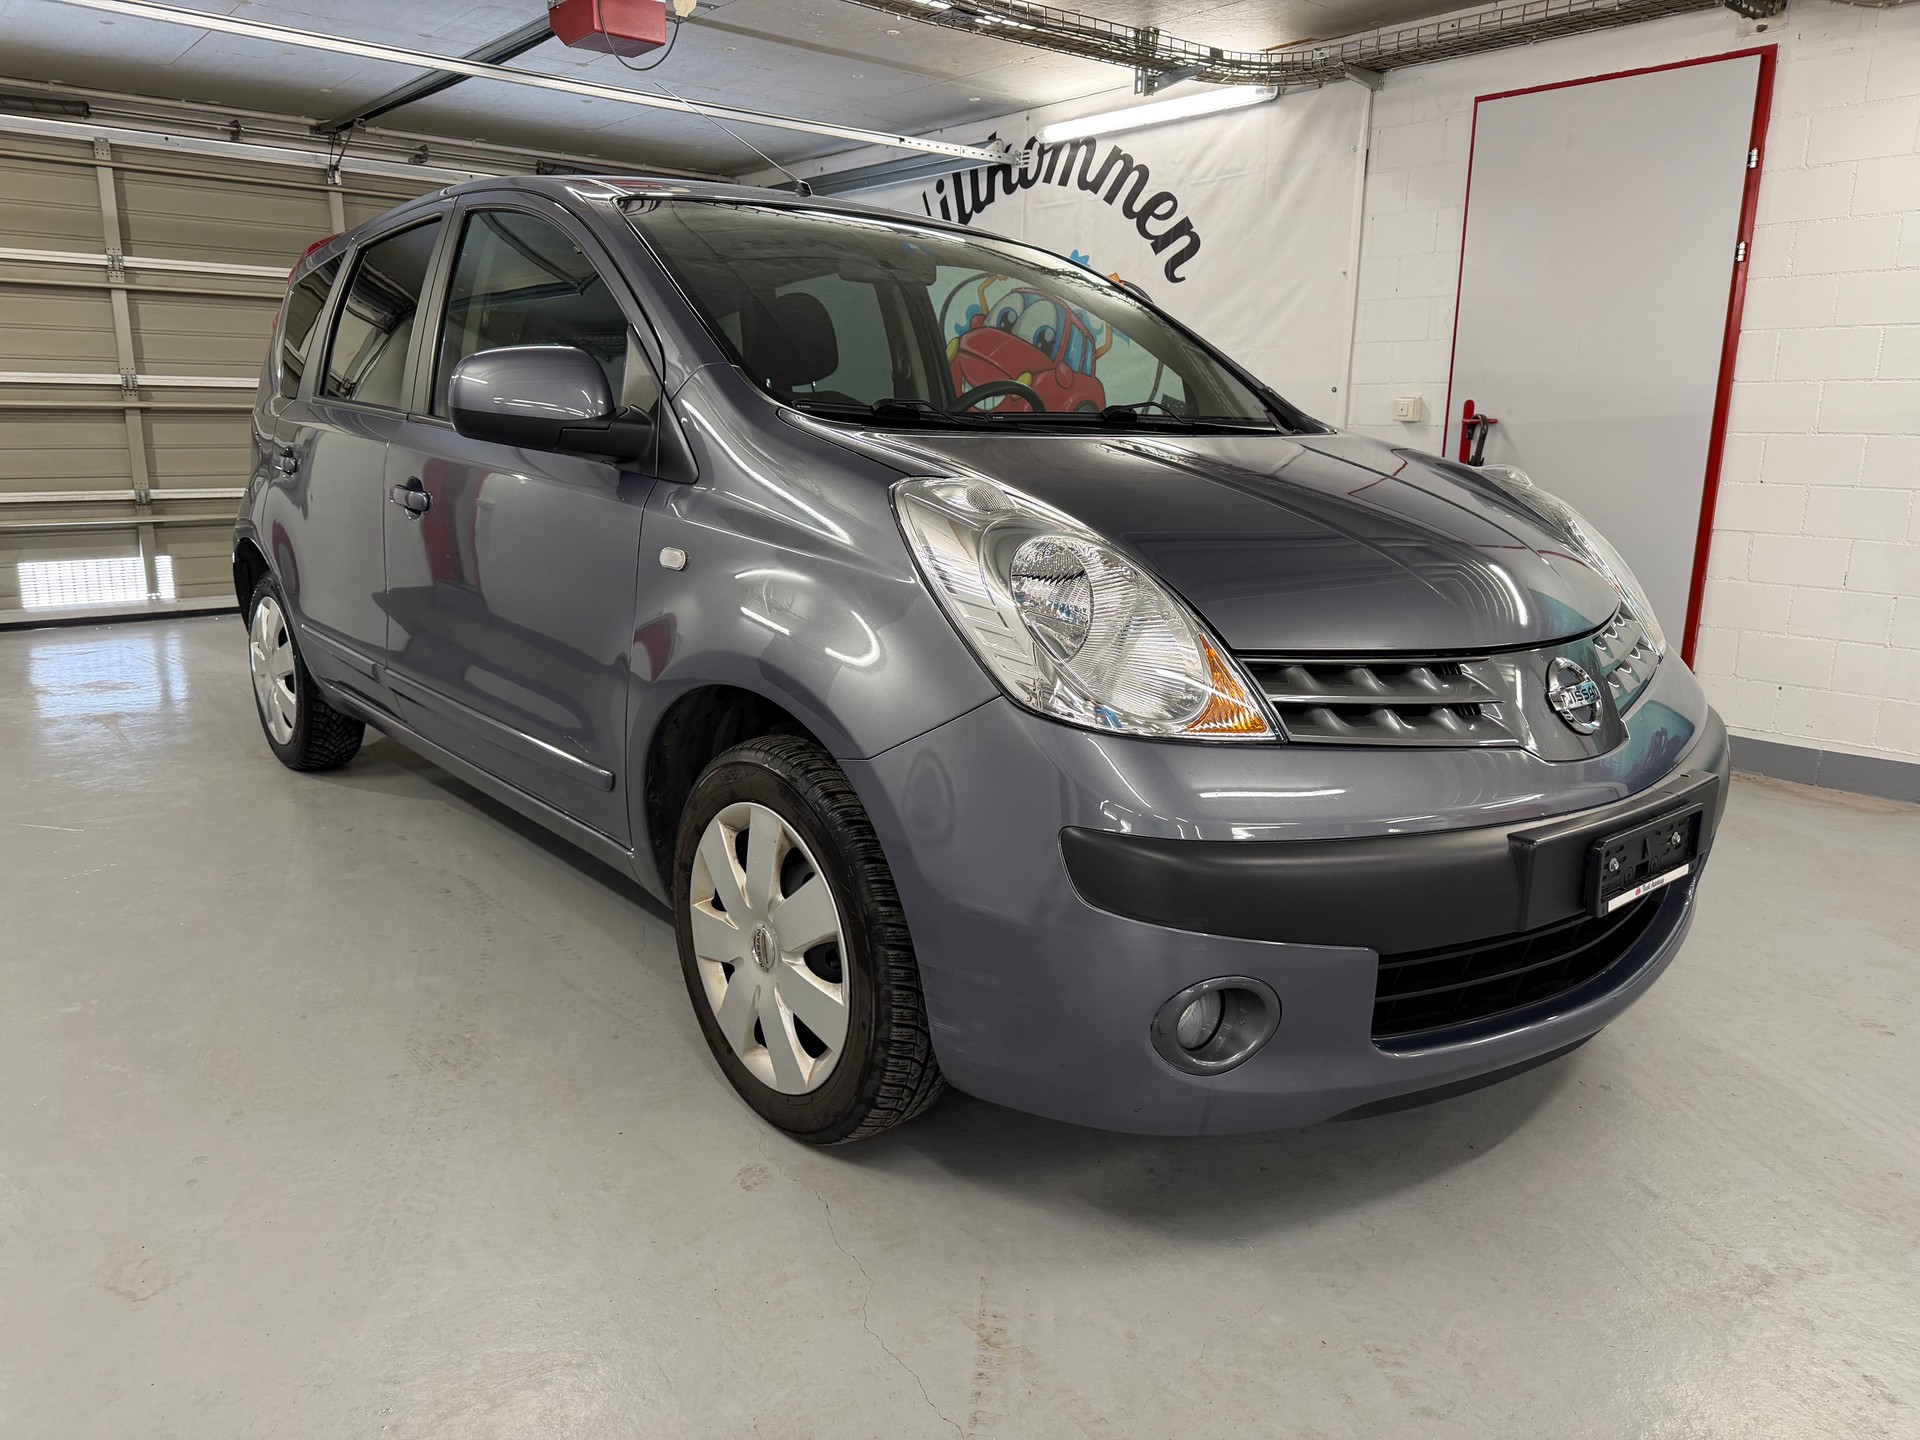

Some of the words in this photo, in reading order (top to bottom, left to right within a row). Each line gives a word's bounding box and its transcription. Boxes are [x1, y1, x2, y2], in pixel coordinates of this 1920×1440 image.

[922, 131, 1201, 283] illkommen
[1561, 684, 1600, 705] NISSAN
[756, 928, 765, 968] NISSAN
